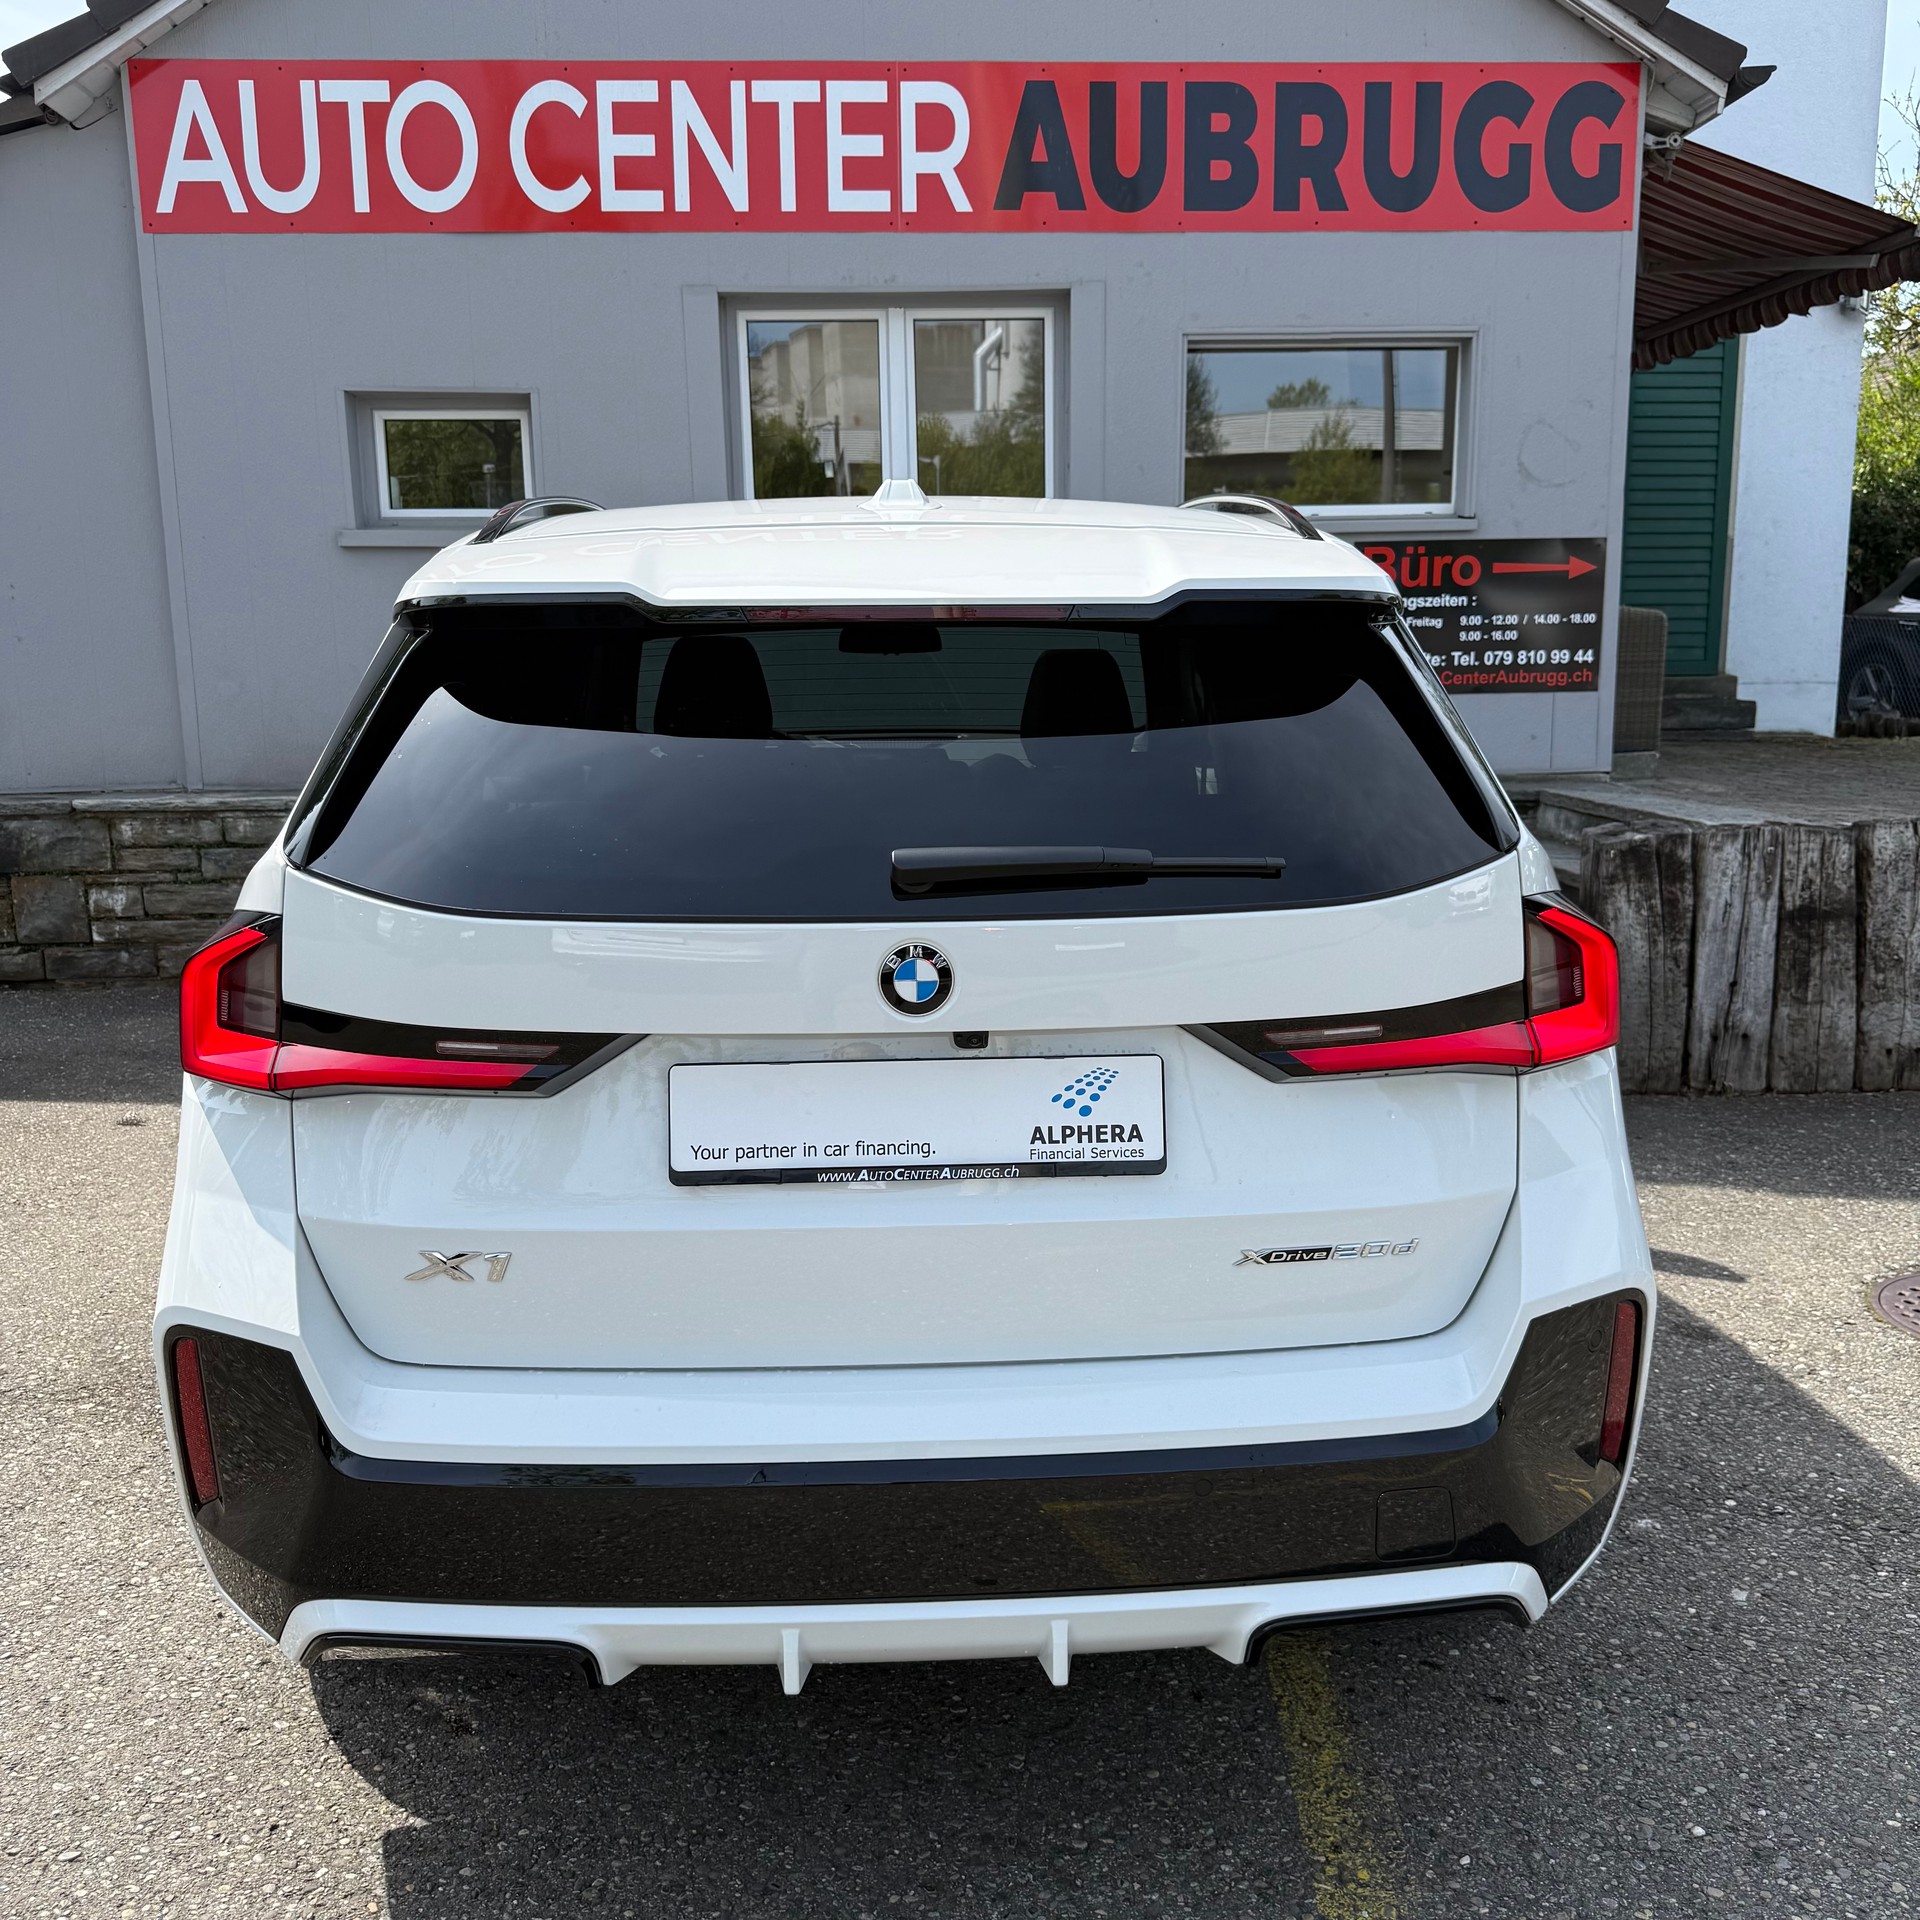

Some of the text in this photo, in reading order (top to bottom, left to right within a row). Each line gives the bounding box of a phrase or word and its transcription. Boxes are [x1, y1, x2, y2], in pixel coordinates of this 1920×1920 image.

[156, 79, 1626, 214] AUTO CENTER AUBRUGG
[1459, 615, 1482, 626] 9.00
[1491, 615, 1519, 625] 12.00
[1533, 614, 1560, 624] 14.00
[1569, 613, 1597, 624] 18.00
[1459, 631, 1481, 641] 9.00
[1491, 630, 1518, 640] 16.00
[1451, 651, 1480, 666] Tel.
[1484, 650, 1513, 665] 079
[1517, 650, 1546, 664] 810
[1550, 650, 1570, 663] 99
[1574, 649, 1594, 663] 44
[886, 945, 948, 970] BMW
[1030, 1124, 1144, 1144] ALPHERA
[690, 1139, 936, 1163] Your partner in car financing.
[1030, 1147, 1145, 1160] Financial Services
[403, 1250, 512, 1281] X1
